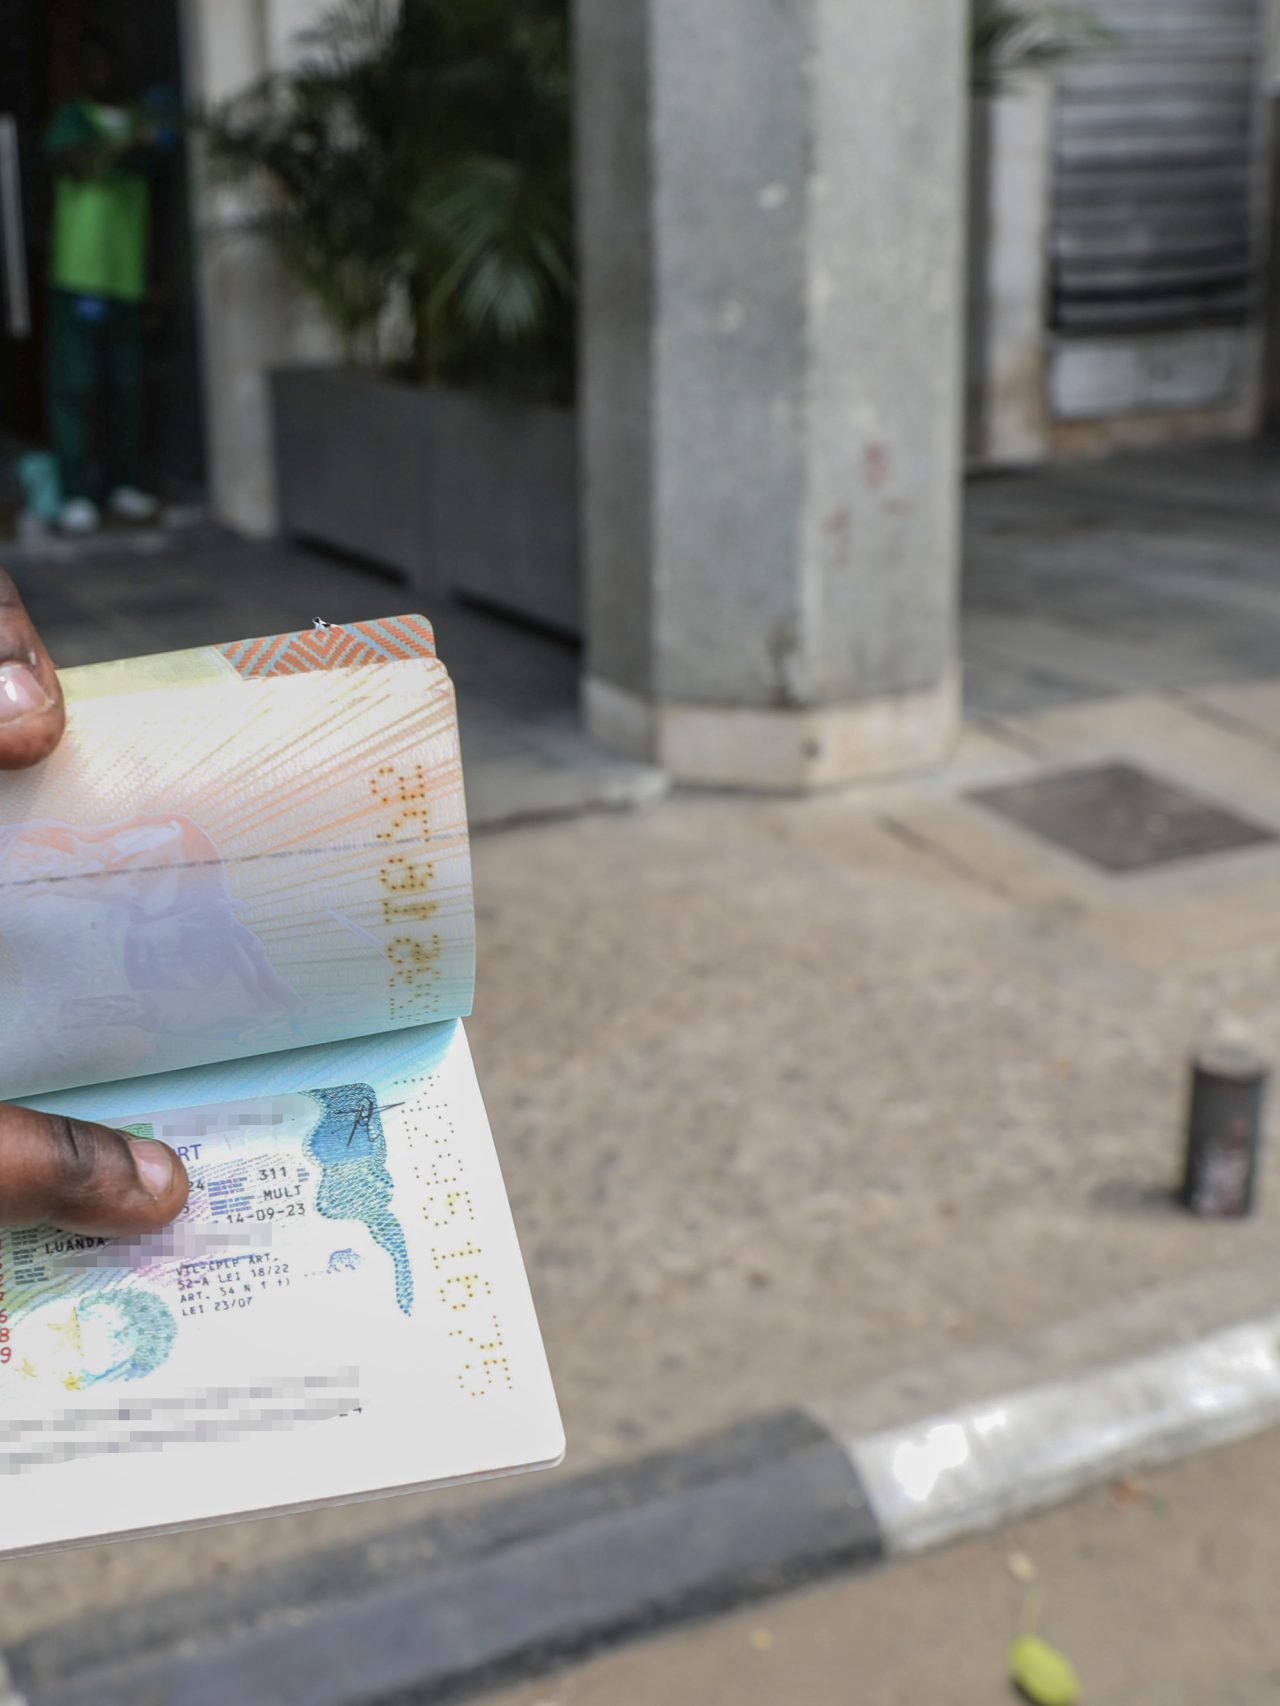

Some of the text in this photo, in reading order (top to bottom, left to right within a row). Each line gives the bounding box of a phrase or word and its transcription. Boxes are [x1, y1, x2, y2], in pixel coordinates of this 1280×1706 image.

[177, 1144, 202, 1162] RT
[258, 1166, 287, 1181] 311
[263, 1184, 301, 1201] MULT
[45, 1237, 105, 1254] LUANDA
[226, 1203, 305, 1224] 14-09-23
[218, 1271, 241, 1284] LEI
[251, 1264, 289, 1278] 18/22
[180, 1291, 210, 1303] ART.
[182, 1296, 252, 1317] LEI 23/07
